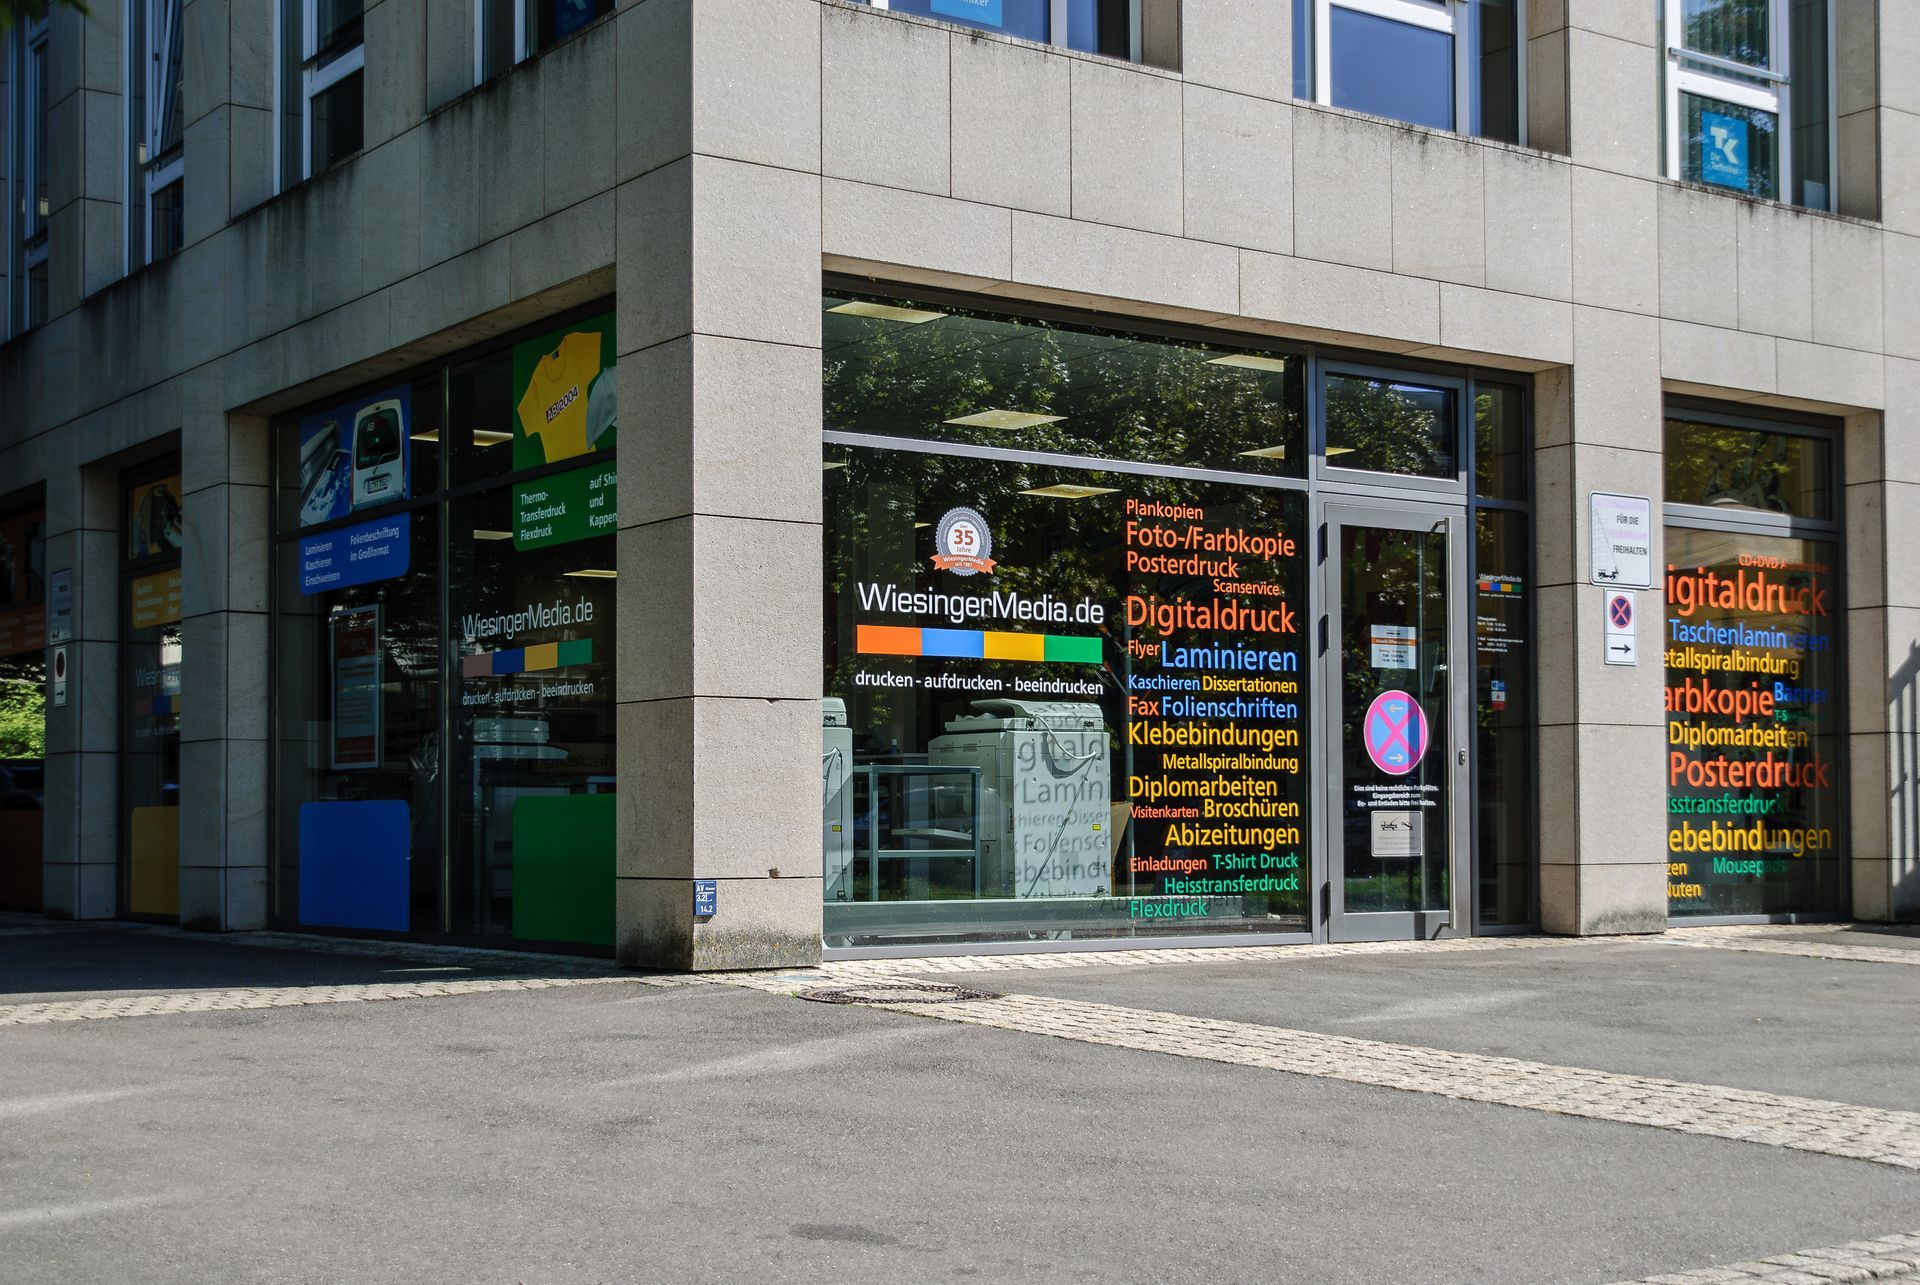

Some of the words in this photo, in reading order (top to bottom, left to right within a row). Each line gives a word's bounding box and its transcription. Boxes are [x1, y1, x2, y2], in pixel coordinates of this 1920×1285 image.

[1710, 126, 1738, 165] TK
[589, 474, 602, 490] auf
[520, 492, 548, 506] Thermo-
[589, 492, 604, 508] und
[520, 503, 566, 523] Transferdruck
[1126, 499, 1204, 522] Plankopien
[1616, 514, 1628, 524] FÜR
[1629, 516, 1639, 526] DIE
[350, 526, 400, 546] Folienbeschriftung
[520, 524, 552, 542] Flexdruck
[954, 529, 974, 546] 35
[1126, 521, 1296, 561] Foto-/Farbkopie
[306, 541, 332, 556] Laminieren
[350, 550, 358, 562] im
[358, 544, 390, 561] Großformat
[956, 546, 972, 554] Jahre
[1612, 544, 1648, 556] FREIHALTEN
[306, 556, 332, 572] Kaschieren
[1127, 551, 1240, 578] Posterdruck
[306, 572, 340, 587] Einschweissen
[1213, 578, 1280, 596] Scanservice
[1662, 564, 1826, 616] igitaldruck
[858, 582, 1104, 624] WiesingerMedia.de
[462, 596, 593, 640] WiesingerMedia.de
[1127, 596, 1296, 636] Digitaldruck
[1669, 618, 1830, 655] Taschenlaminieren
[1128, 639, 1160, 659] Flyer
[1162, 640, 1297, 672] Laminieren
[855, 670, 913, 688] drucken
[924, 673, 1002, 691] aufdrucken
[1014, 676, 1104, 695] beeindrucken
[1128, 674, 1200, 691] Kaschieren
[1202, 676, 1298, 694] Dissertationen
[462, 692, 490, 706] drucken
[495, 686, 536, 704] aufdrucken
[542, 681, 594, 698] beeindrucken
[1774, 682, 1829, 705] Banner
[1128, 696, 1159, 716] Fax
[1162, 696, 1298, 718] Folienschriften
[1128, 720, 1298, 752] Klebebindungen
[1669, 720, 1808, 751] Diplomarbeiten
[1162, 752, 1298, 774] Metallspiralbindung
[1670, 751, 1830, 790] Posterdruck
[1129, 775, 1278, 802] Diplomarbeiten
[1372, 792, 1410, 800] Eingangsbereich
[1130, 805, 1199, 819] Visitenkarten
[1204, 799, 1299, 818] Broschüren
[1165, 823, 1300, 850] Abizeitungen
[1130, 856, 1208, 874] Einladungen
[1213, 854, 1256, 870] T-Shirt
[1260, 852, 1298, 869] Druck
[1714, 856, 1787, 878] Mousepads
[1164, 874, 1298, 894] Heisstransferdruck
[1130, 899, 1208, 918] Flexdruck
